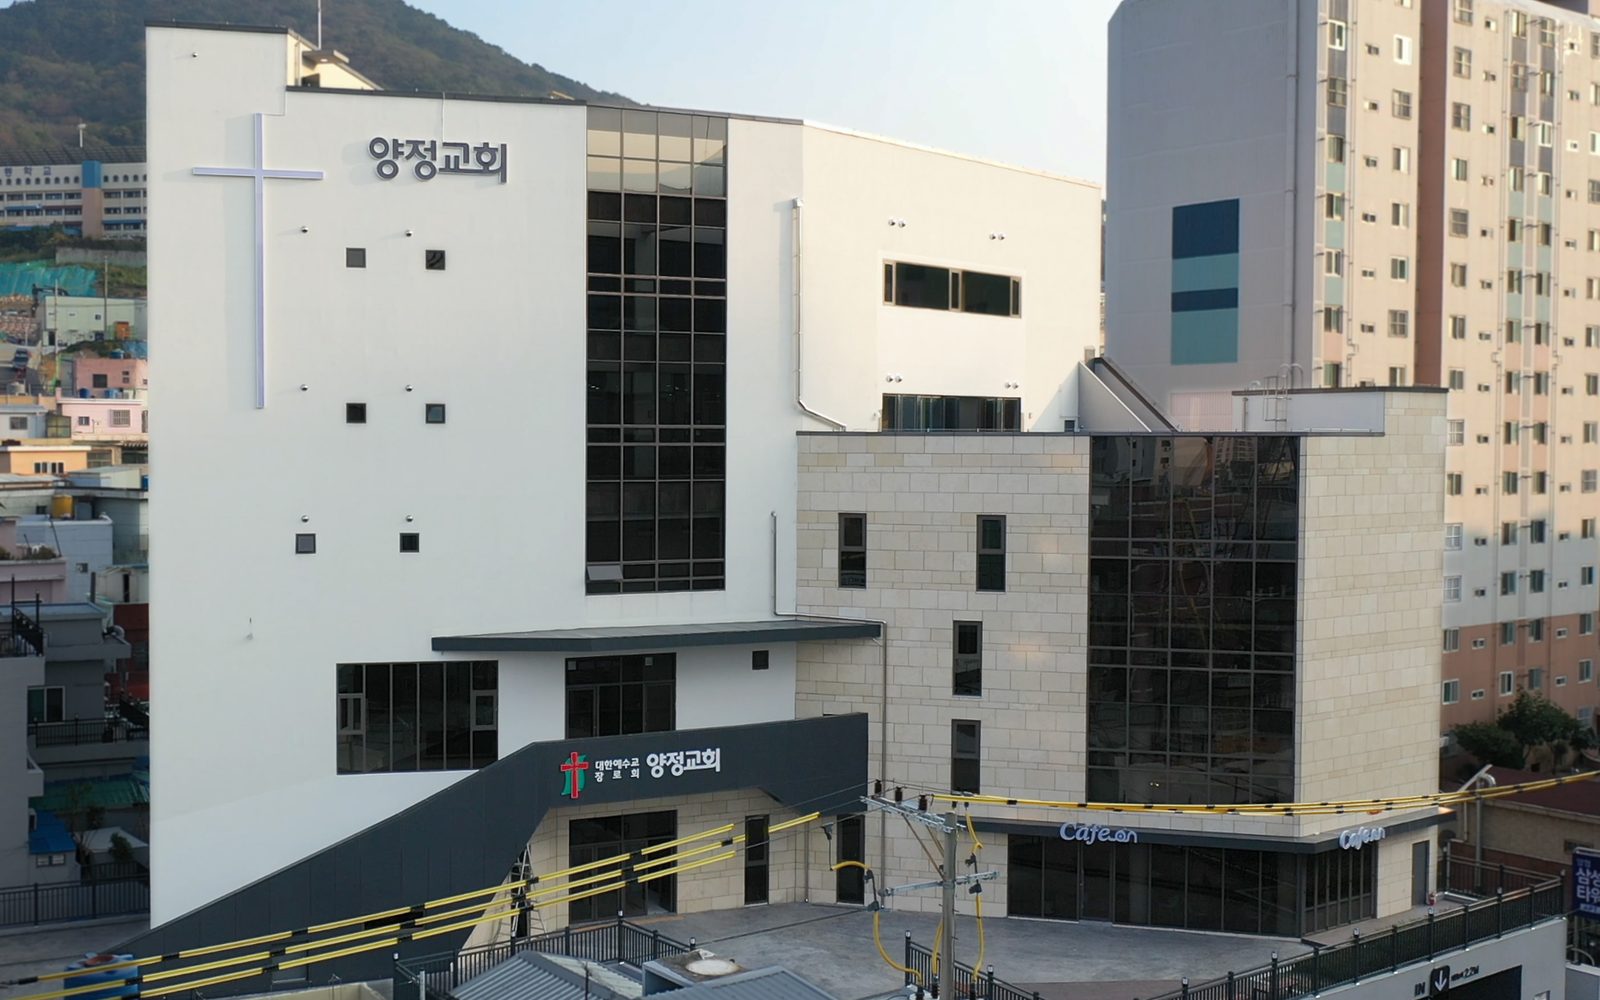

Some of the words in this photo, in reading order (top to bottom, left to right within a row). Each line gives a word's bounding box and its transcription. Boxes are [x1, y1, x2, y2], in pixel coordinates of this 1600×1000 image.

[369, 137, 507, 183] 양정교회
[595, 758, 640, 770] 대한예수교
[646, 748, 721, 778] 양정교회
[1414, 981, 1426, 997] IN
